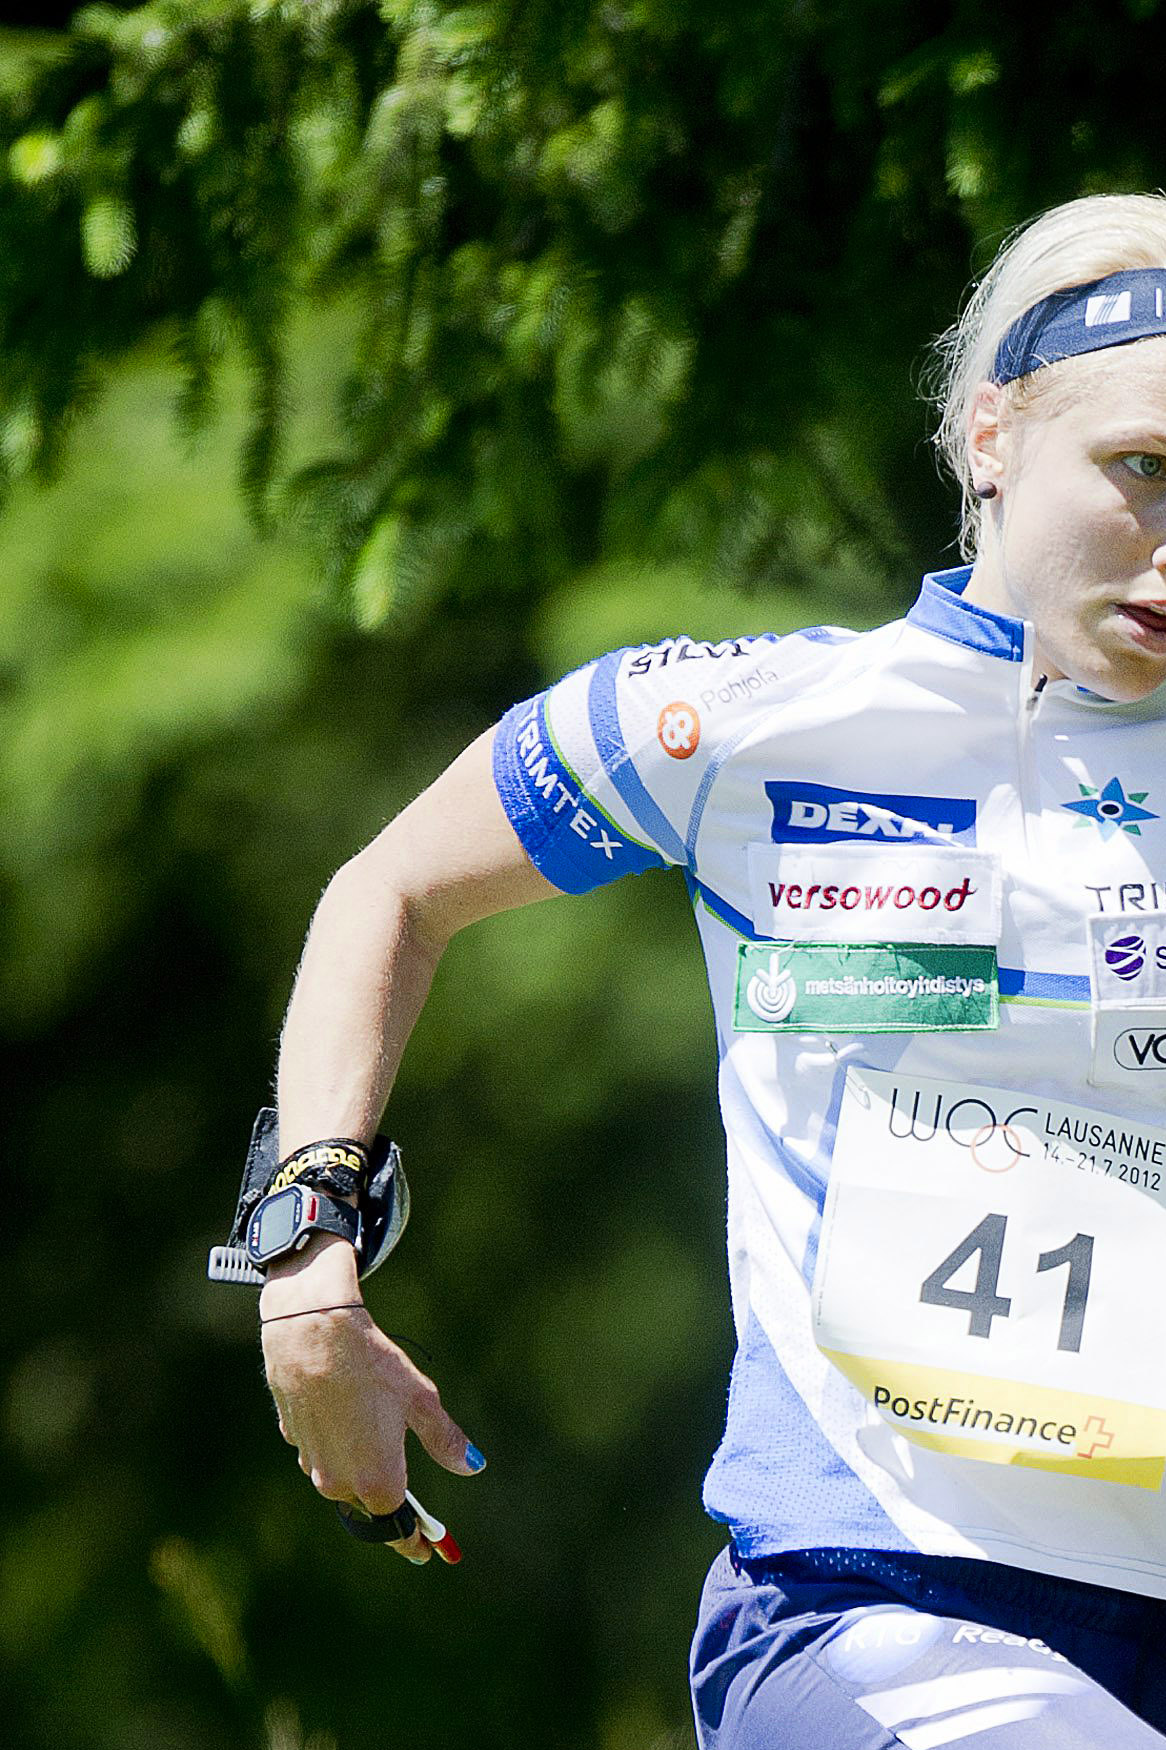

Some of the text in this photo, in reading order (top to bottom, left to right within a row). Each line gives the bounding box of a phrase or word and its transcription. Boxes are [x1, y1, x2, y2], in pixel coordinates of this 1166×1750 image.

[700, 667, 779, 712] Pohjola
[517, 701, 624, 860] TRIMTEX
[787, 800, 954, 840] DEX
[768, 877, 978, 911] versowood
[804, 975, 986, 999] metsänhoitoyhdistys
[888, 1087, 1039, 1158] WOC
[1045, 1112, 1166, 1166] LAUSANNE
[918, 1212, 1095, 1354] 41
[873, 1385, 1078, 1445] PostFinance
